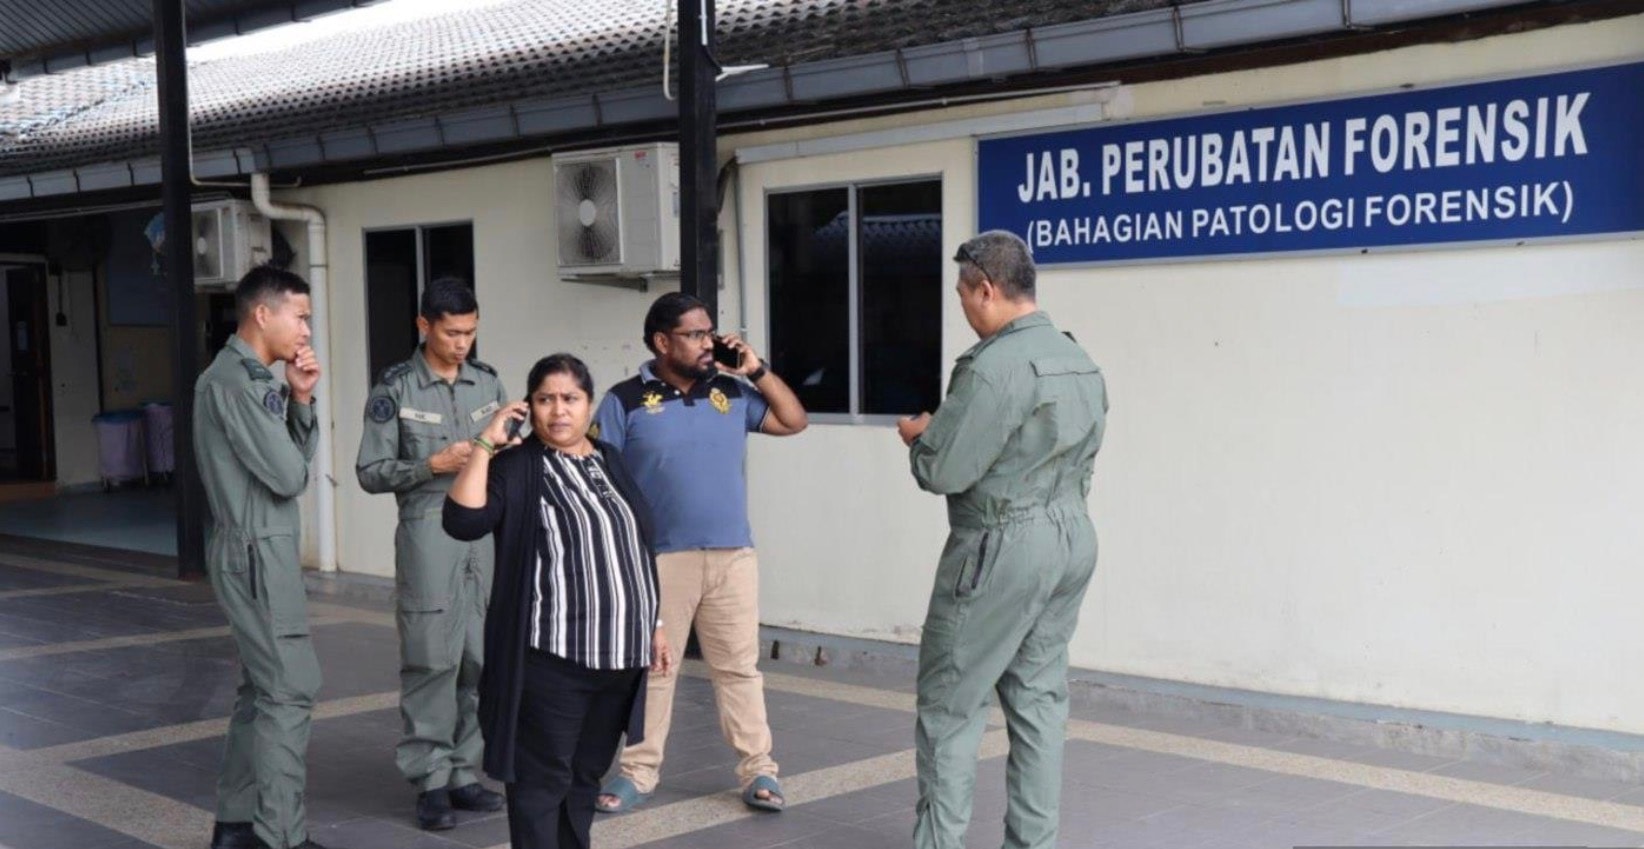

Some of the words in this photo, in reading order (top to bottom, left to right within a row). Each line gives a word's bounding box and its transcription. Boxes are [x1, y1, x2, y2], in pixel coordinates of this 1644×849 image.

[1018, 149, 1091, 203] JAB.
[1102, 125, 1331, 195] PERUBATAN
[1344, 92, 1591, 176] FORENSIK
[1027, 210, 1183, 254] (BAHAGIAN
[1192, 197, 1355, 238] PATOLOGI
[1365, 180, 1574, 227] FORENSIK)
